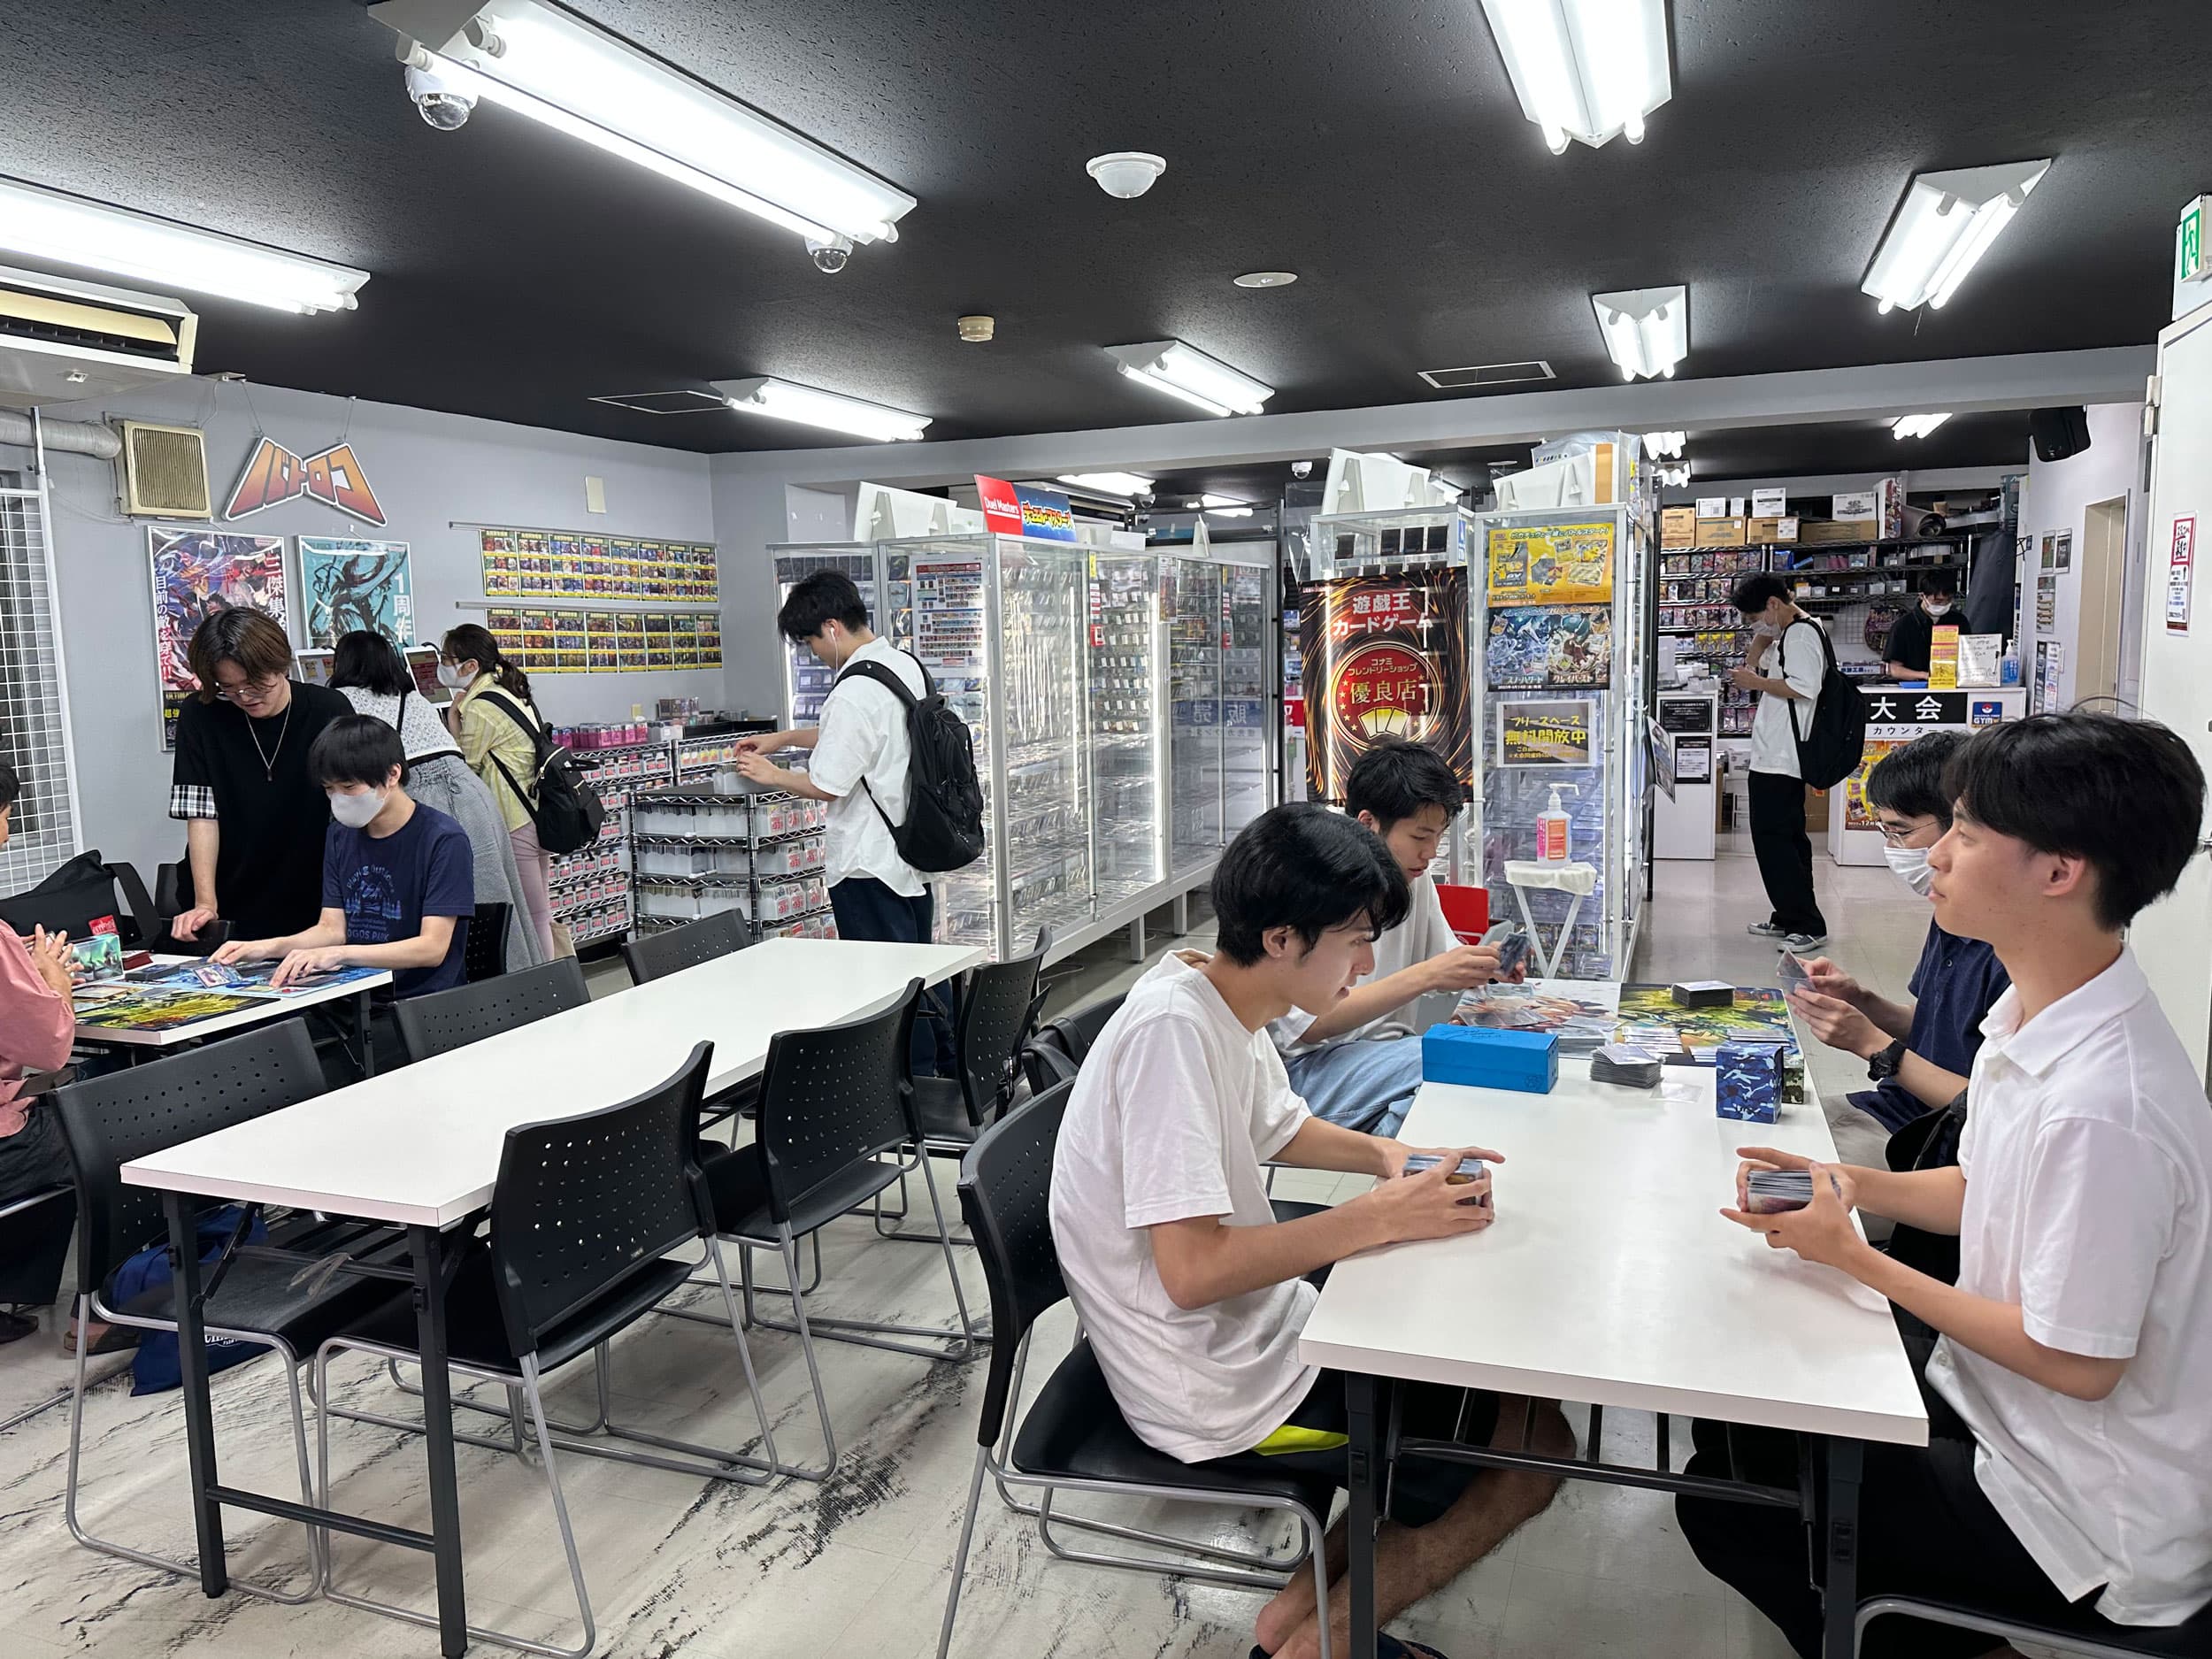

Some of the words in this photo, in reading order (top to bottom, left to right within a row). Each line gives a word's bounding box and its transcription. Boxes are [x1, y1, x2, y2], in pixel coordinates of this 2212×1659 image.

[228, 440, 386, 525] バトロコ
[984, 496, 999, 511] Duel
[997, 499, 1019, 514] Masters
[1352, 592, 1411, 614] 遊戯王
[1332, 612, 1433, 636] カードゲーム
[1347, 662, 1418, 676] フレンドリーショップ
[1371, 657, 1393, 666] コナミ
[1349, 679, 1417, 704] 優良店
[1506, 728, 1586, 745] 無料開放中
[1873, 726, 1938, 735] カウンター
[348, 928, 370, 940] OGOS
